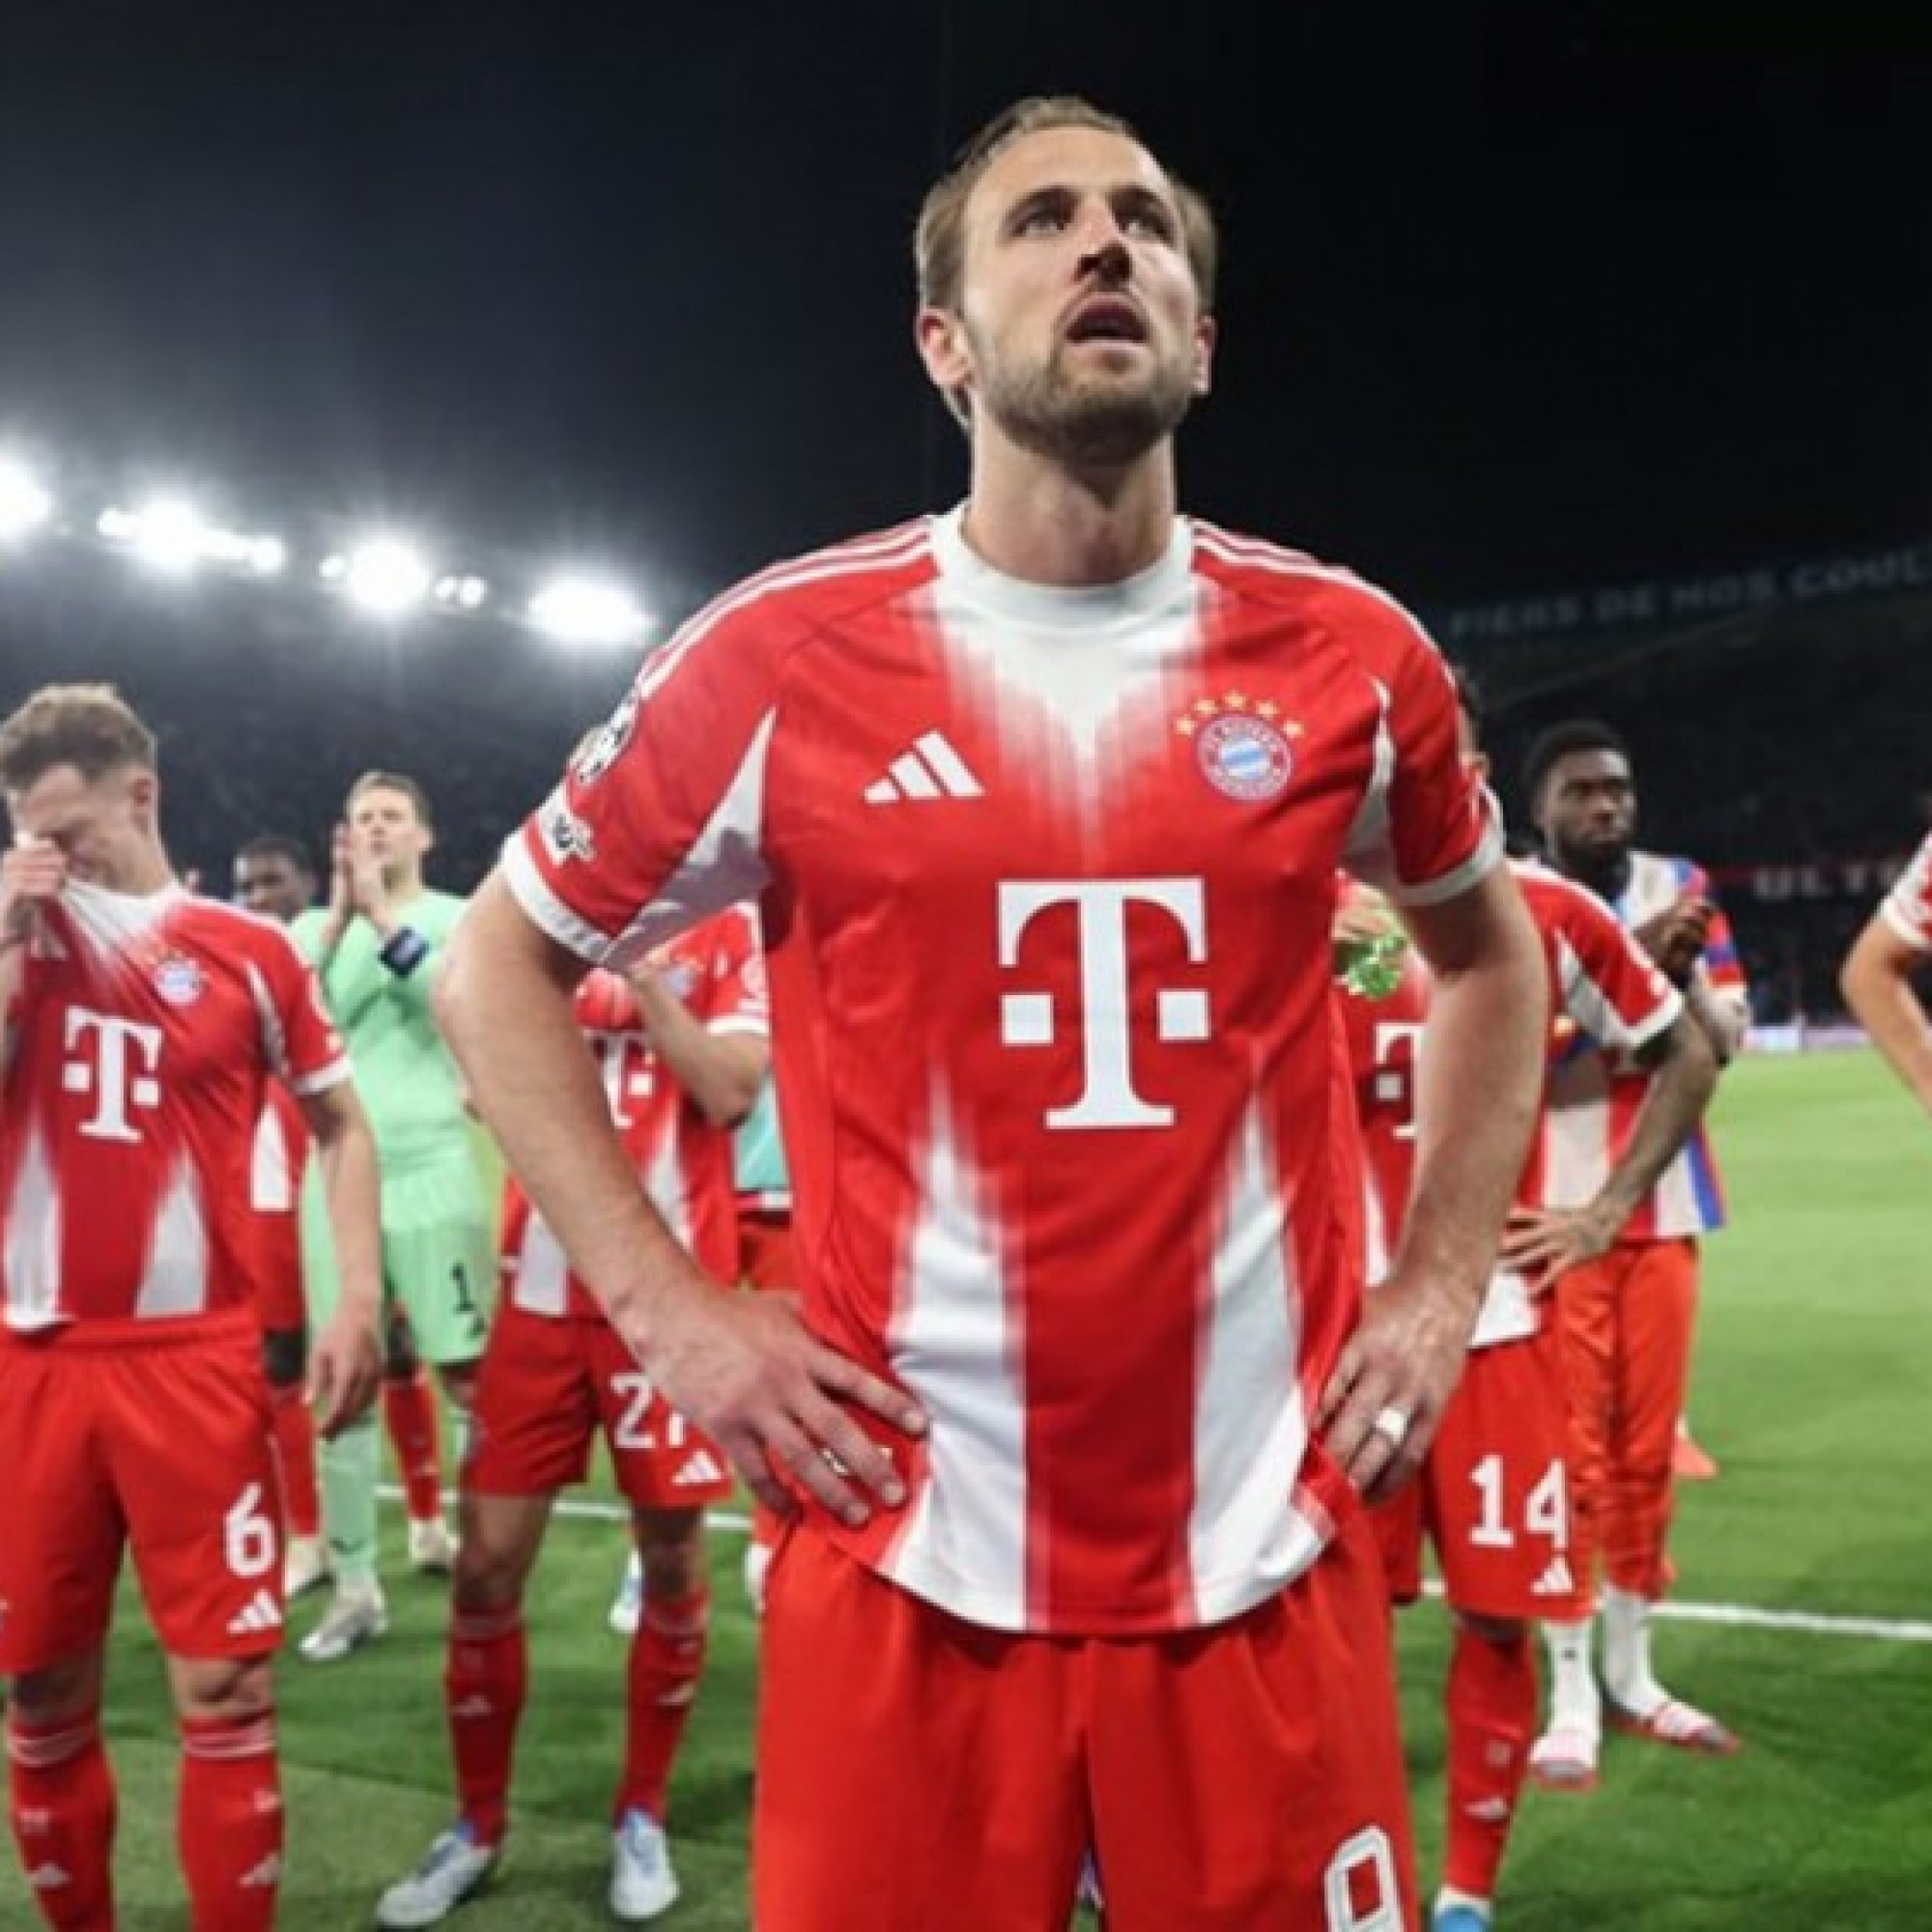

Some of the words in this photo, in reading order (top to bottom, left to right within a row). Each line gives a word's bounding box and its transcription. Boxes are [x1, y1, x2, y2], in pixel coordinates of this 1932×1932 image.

[997, 877, 1208, 1129] T
[63, 1007, 162, 1143] T
[449, 1262, 477, 1312] 1
[223, 1483, 275, 1577] 6
[1469, 1455, 1569, 1550] 14
